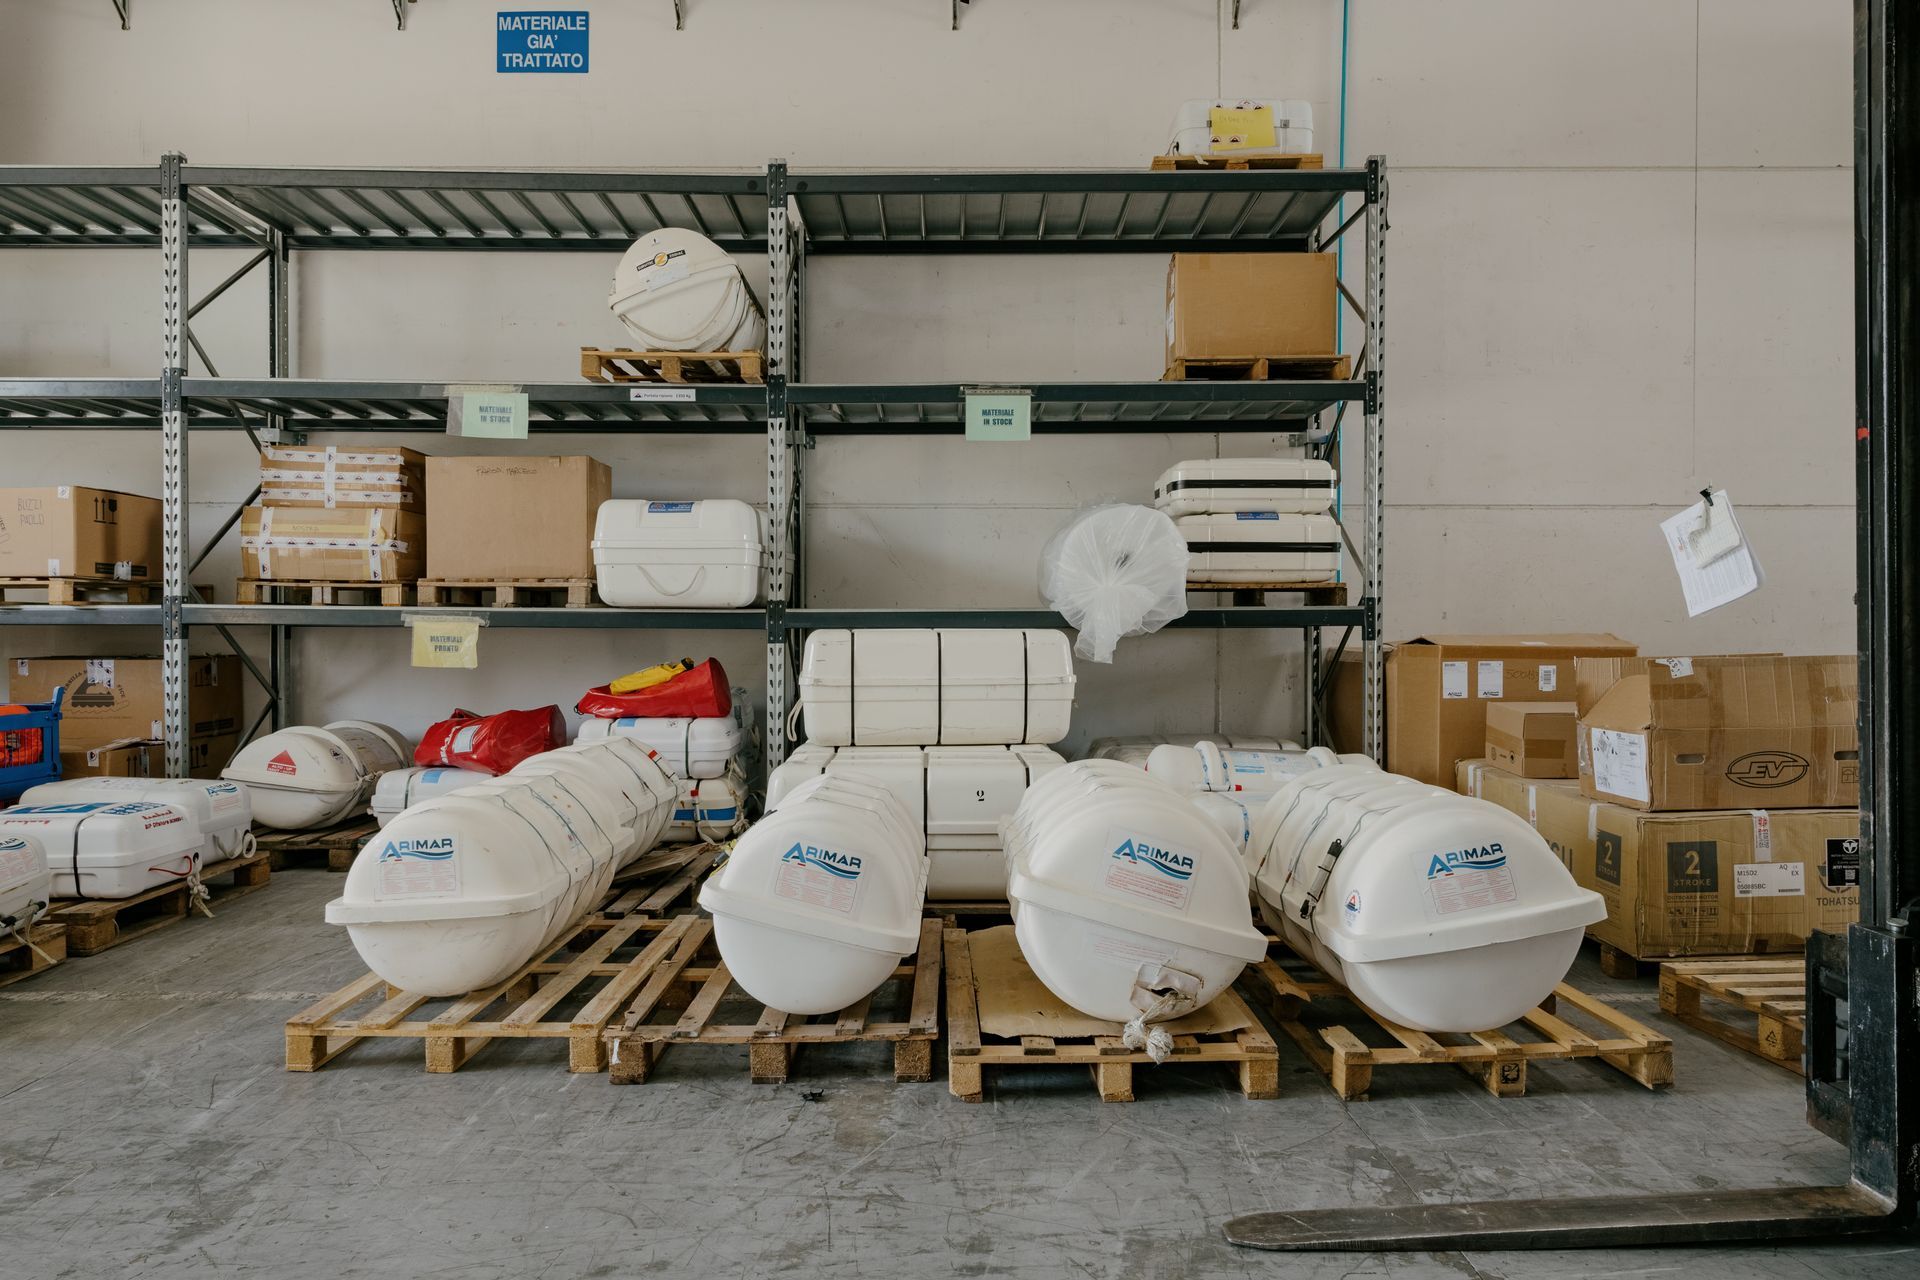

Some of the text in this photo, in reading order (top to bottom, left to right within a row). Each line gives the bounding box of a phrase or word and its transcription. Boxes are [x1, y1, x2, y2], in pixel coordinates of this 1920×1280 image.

[498, 16, 586, 31] MATERIALE
[502, 53, 584, 68] TRATTATO
[479, 405, 512, 414] MATERIALE
[480, 415, 511, 423] IN STOCK
[984, 418, 1013, 426] IN STOCK
[430, 635, 463, 643] MATERIALE
[434, 644, 459, 652] PRONTO
[976, 790, 985, 802] 2
[380, 839, 453, 859] ARIMAR
[783, 842, 862, 869] ARIMAR
[1112, 838, 1194, 869] ARIMAR
[1604, 841, 1613, 865] 2
[1427, 843, 1504, 876] ARIMAR
[1685, 850, 1700, 875] 2
[1598, 865, 1618, 879] STROKE
[1673, 879, 1712, 887] STROKE
[1816, 897, 1860, 907] TOHATSU
